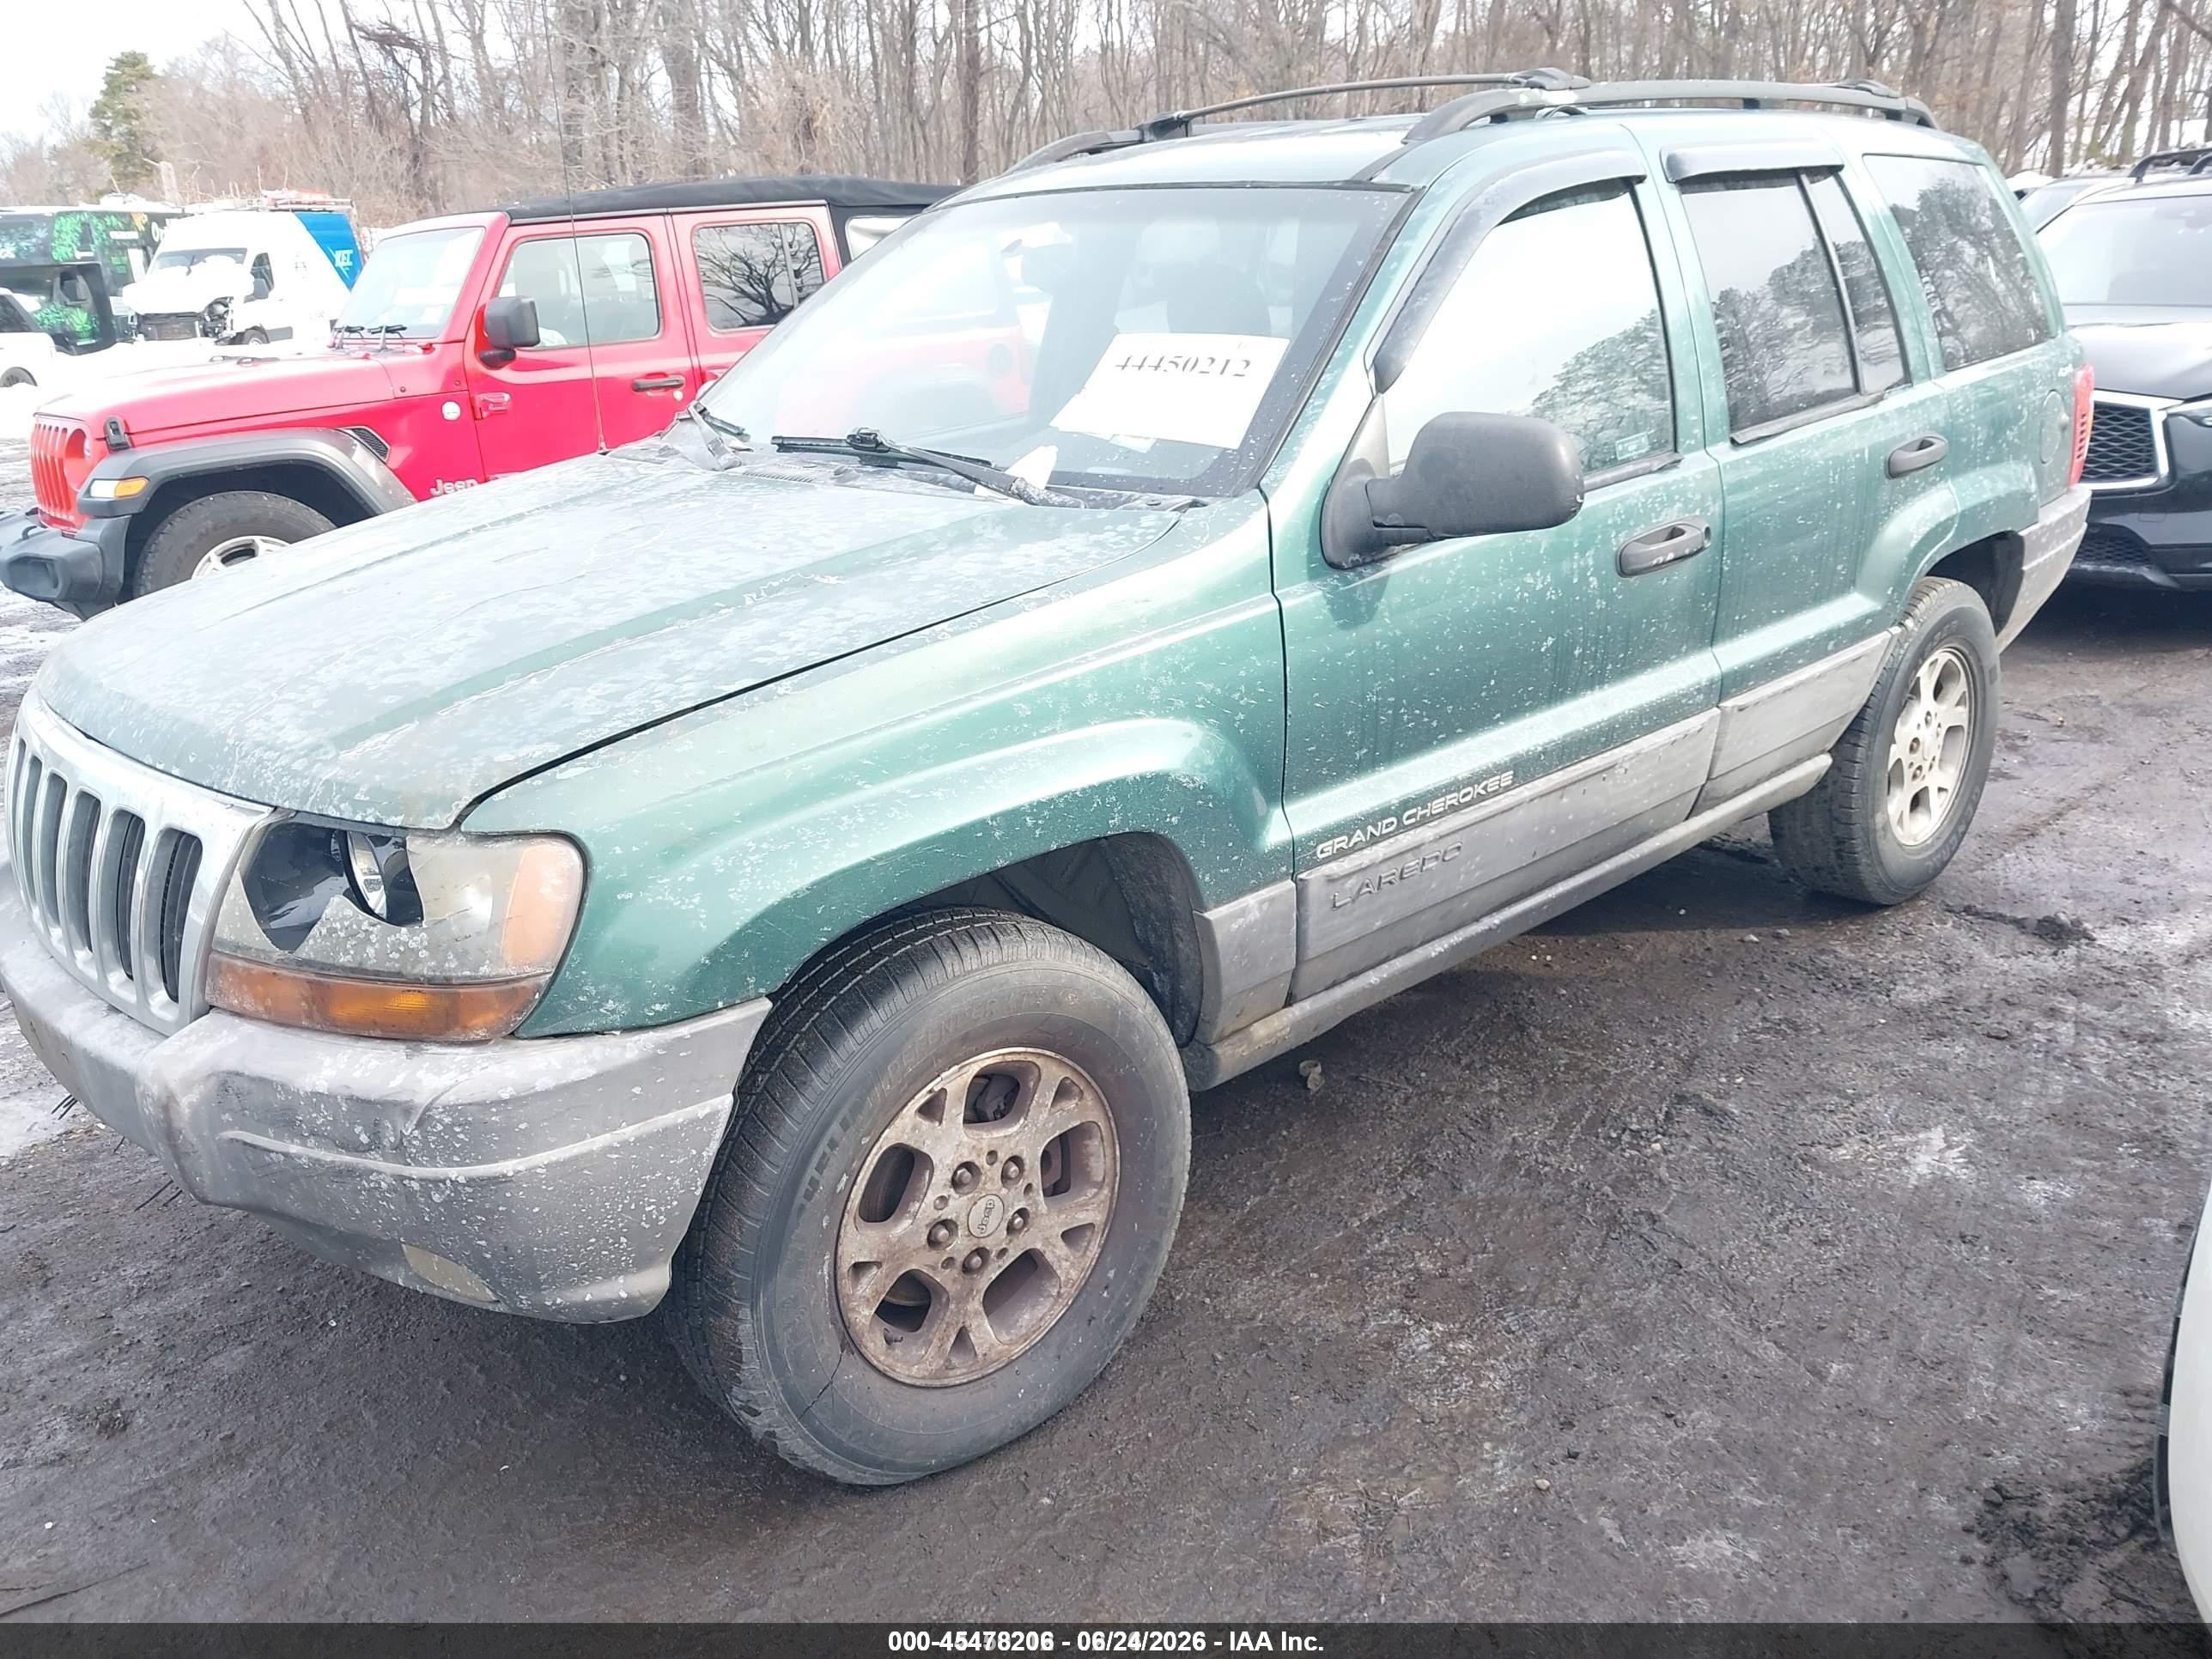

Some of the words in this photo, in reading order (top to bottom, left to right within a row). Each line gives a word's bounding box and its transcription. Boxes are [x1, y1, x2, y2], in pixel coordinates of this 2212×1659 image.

[1115, 356, 1251, 377] 44450212
[1316, 817, 1398, 859] GRAND
[1402, 771, 1514, 826] CHEROKEE
[1332, 841, 1463, 911] LAREDO
[977, 1199, 995, 1234] Jeep
